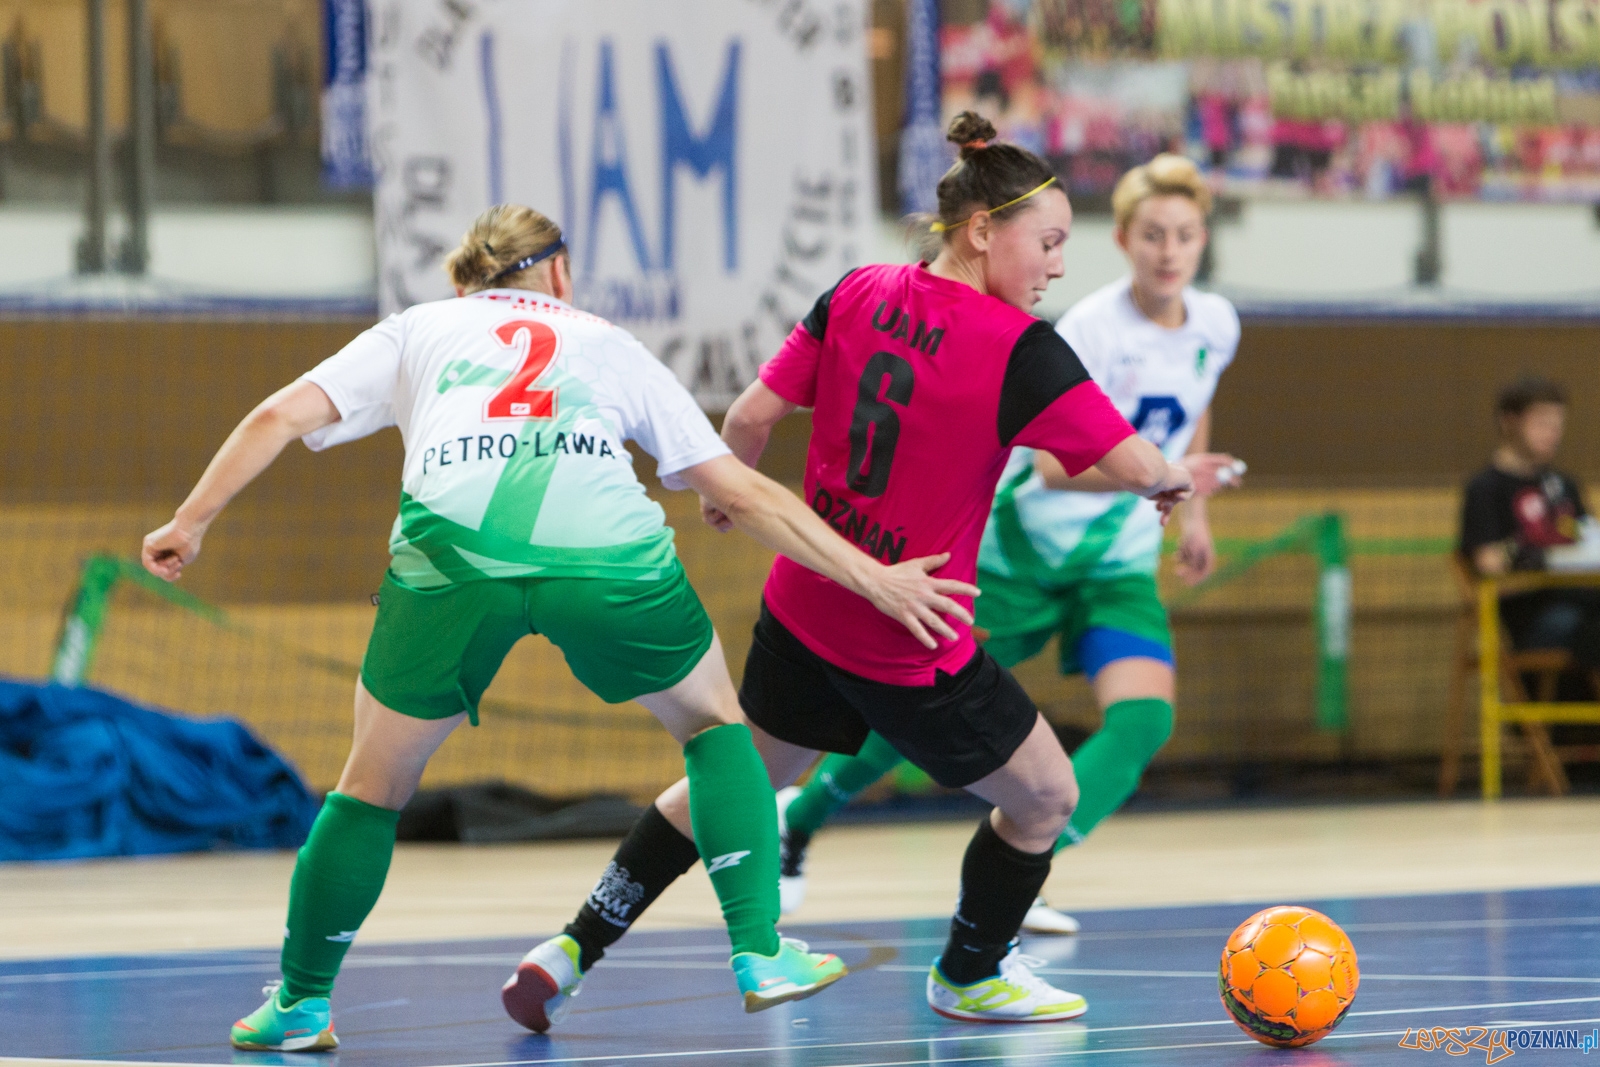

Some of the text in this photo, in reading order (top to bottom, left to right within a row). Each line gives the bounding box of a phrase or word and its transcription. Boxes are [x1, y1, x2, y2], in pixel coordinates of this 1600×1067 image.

[482, 315, 562, 422] 2
[872, 301, 945, 355] UAM
[423, 431, 616, 475] PETRO-LAWA
[846, 351, 915, 498] 6
[811, 481, 907, 565] OZNAŃ
